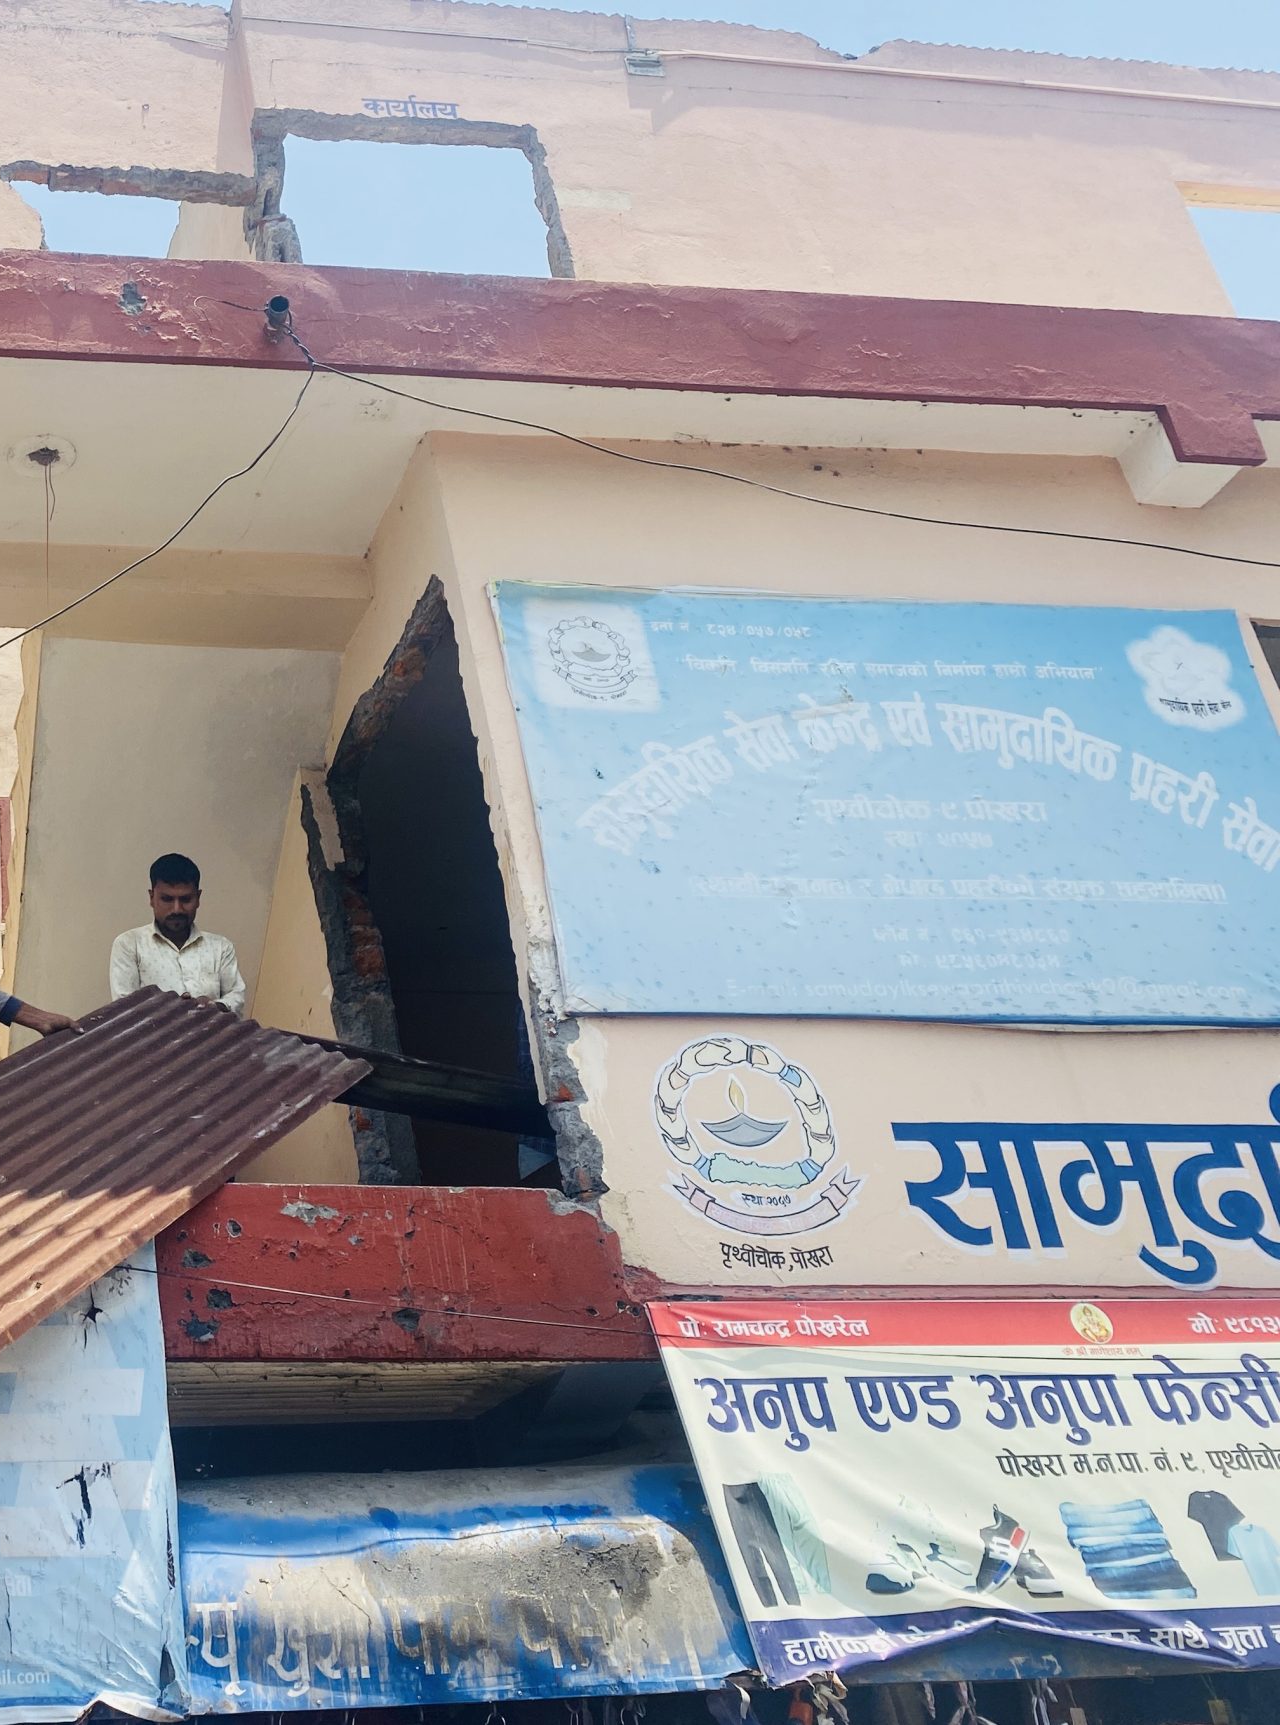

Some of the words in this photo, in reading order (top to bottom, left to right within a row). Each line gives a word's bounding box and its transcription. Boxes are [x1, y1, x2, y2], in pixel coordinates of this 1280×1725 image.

[361, 95, 460, 118] कार्यालय
[721, 710, 800, 773] सेवा
[935, 700, 1122, 771] सामुदायिक
[1129, 750, 1220, 830] प्रहरी
[891, 1083, 1280, 1285] सामुदा
[711, 1319, 790, 1339] रामचन्द्र
[793, 1314, 871, 1338] पोखरेल
[694, 1376, 837, 1451] अनुप
[845, 1375, 962, 1432] एण्ड
[970, 1374, 1133, 1446] अनुपा
[996, 1447, 1068, 1478] पोखरा
[1150, 1620, 1210, 1650] साथै
[1210, 1625, 1268, 1656] जुत्ता
